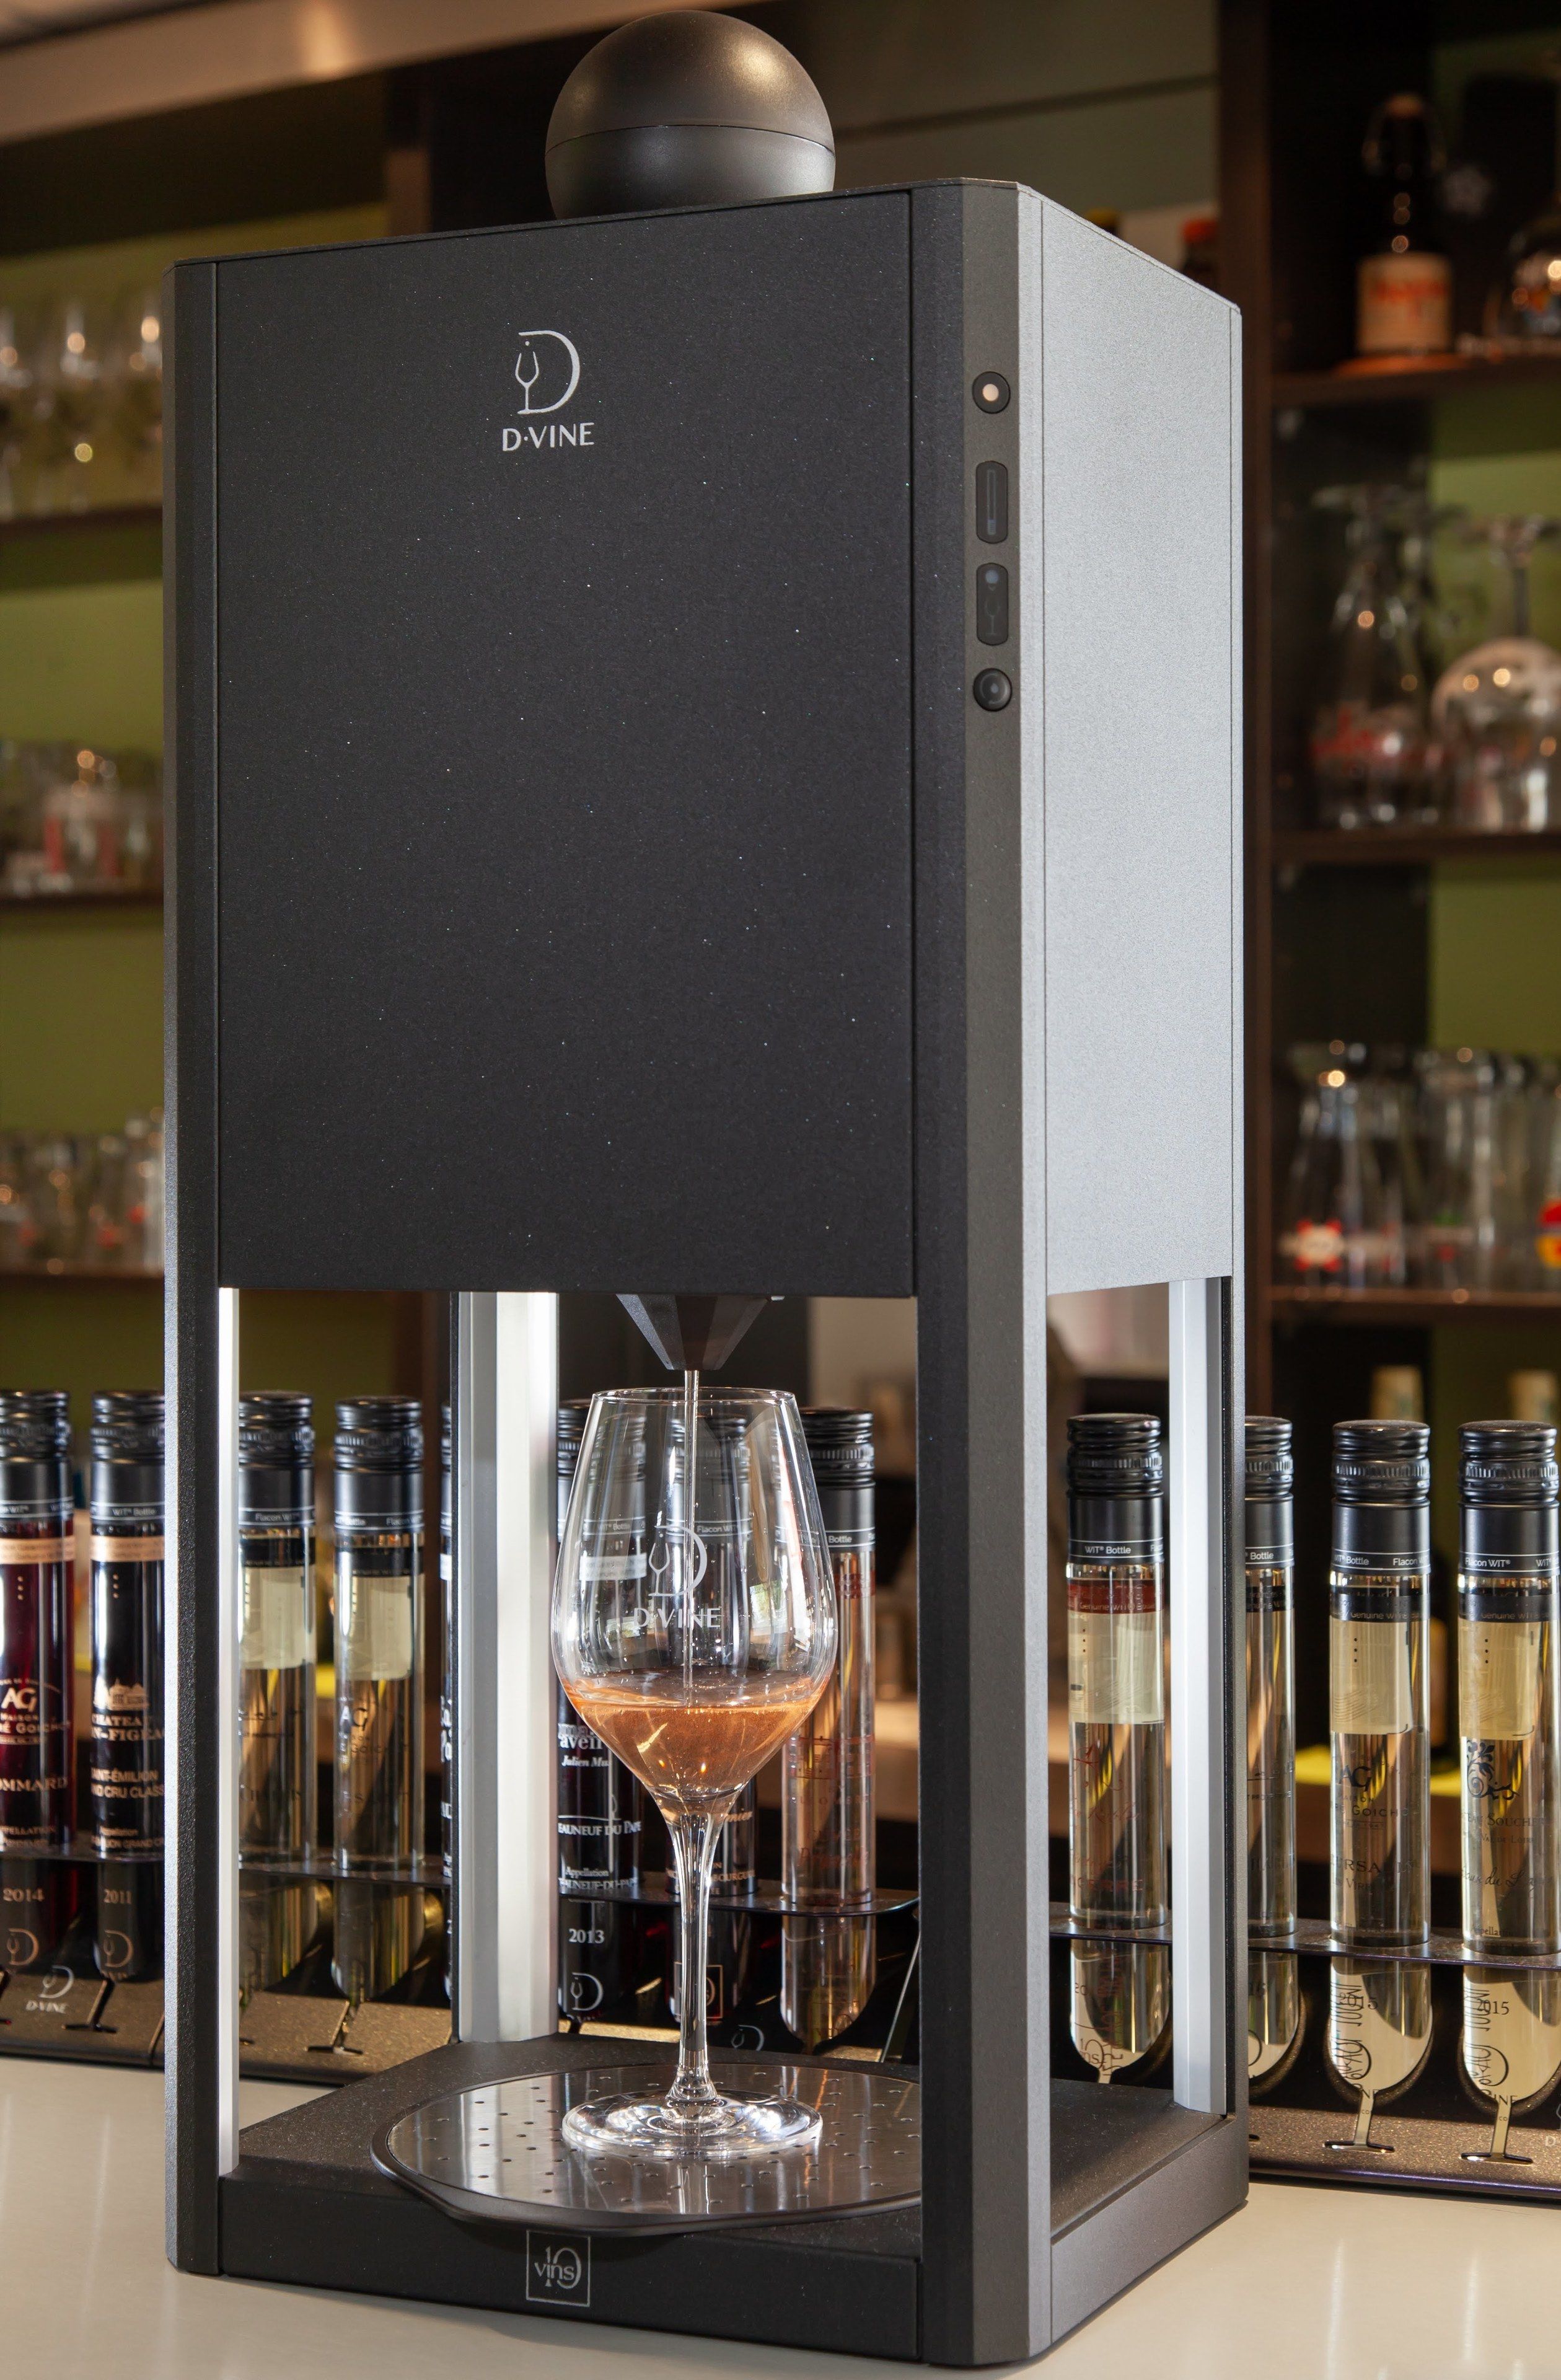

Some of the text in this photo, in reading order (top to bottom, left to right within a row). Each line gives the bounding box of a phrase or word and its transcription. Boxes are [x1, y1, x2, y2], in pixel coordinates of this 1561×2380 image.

[697, 1525, 723, 1533] Flacon
[828, 1535, 852, 1543] Bottle
[1250, 1552, 1274, 1560] Bottle
[1346, 1556, 1370, 1565] Bottle
[1393, 1558, 1418, 1566] Flacon
[3, 1887, 45, 1902] 2014
[103, 1889, 132, 1904] 2011
[568, 1928, 605, 1944] 2013
